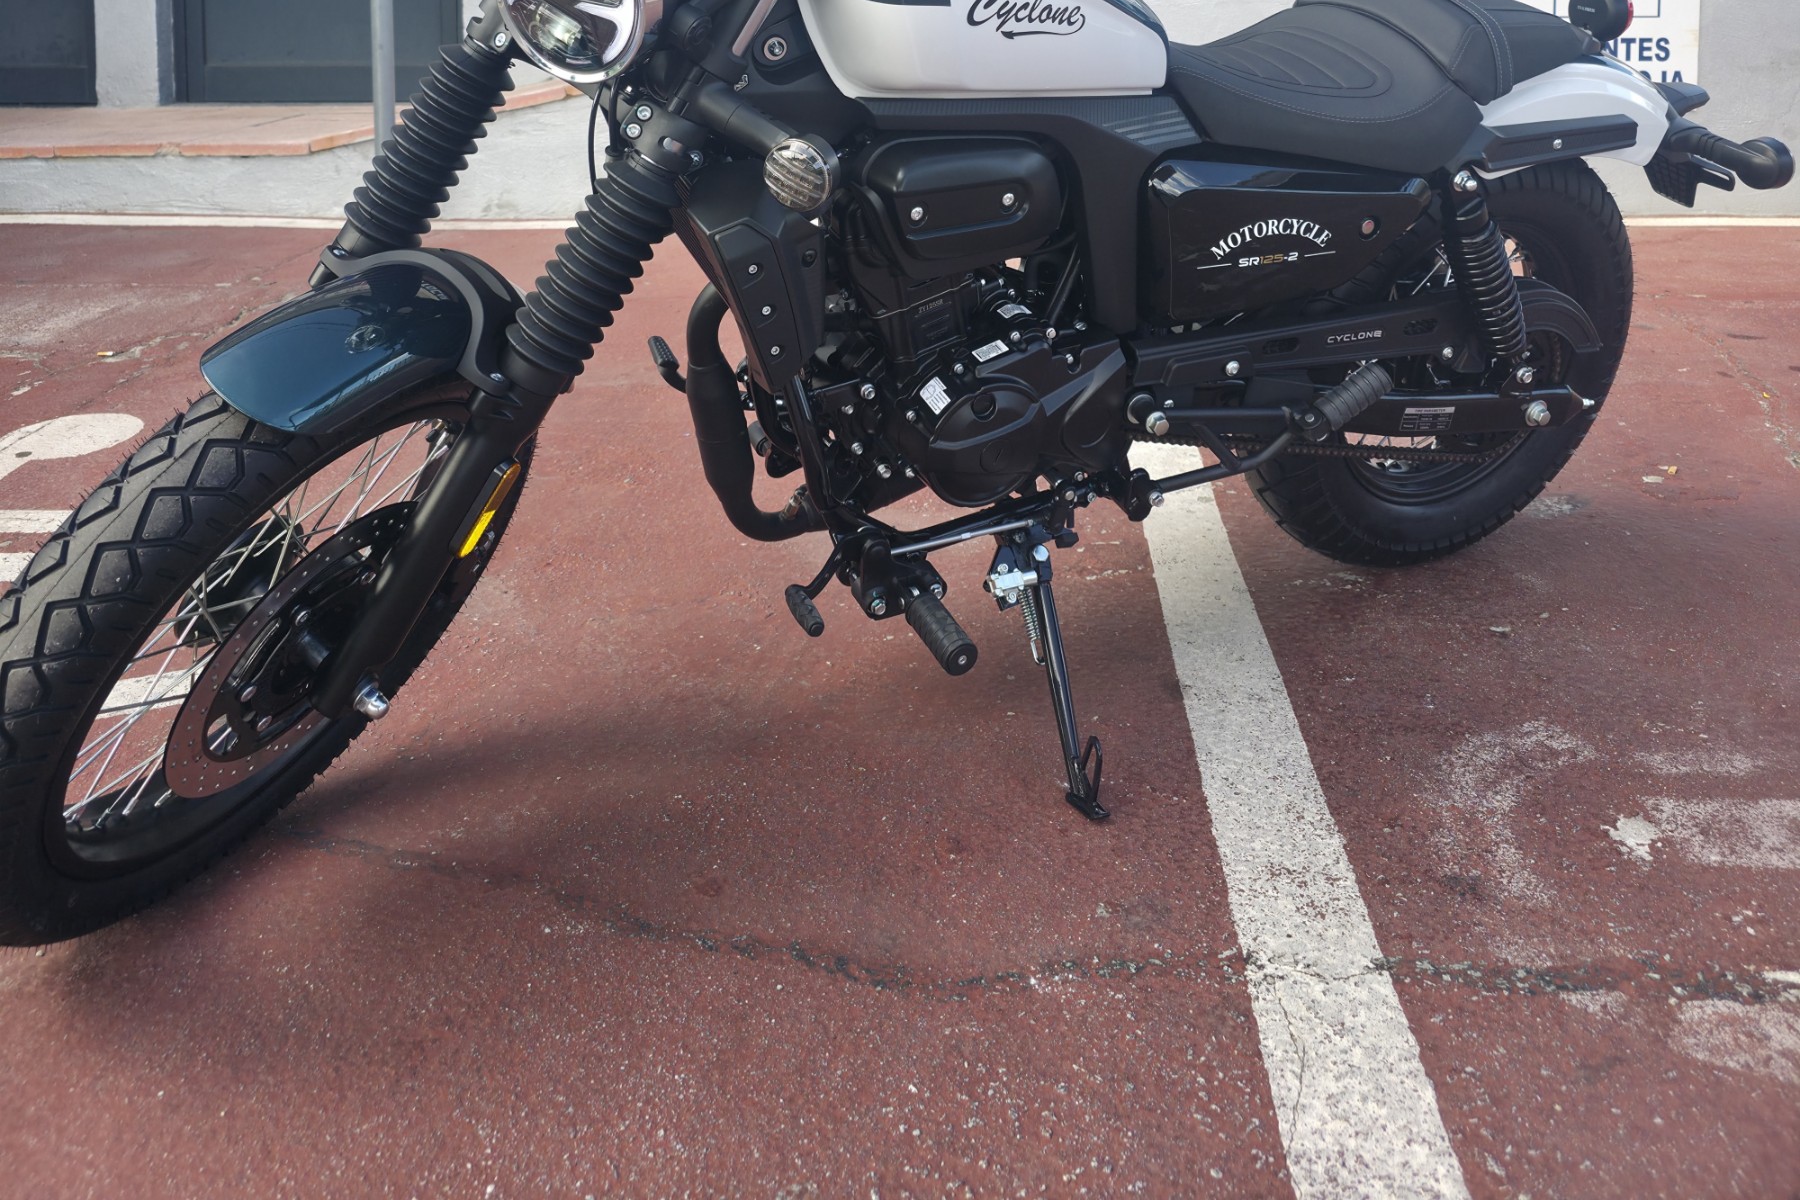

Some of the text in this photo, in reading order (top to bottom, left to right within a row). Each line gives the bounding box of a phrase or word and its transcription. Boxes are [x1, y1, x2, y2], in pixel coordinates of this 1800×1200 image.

[1603, 37, 1671, 62] NTES
[1210, 218, 1332, 260] MOTORCYCLE
[1238, 251, 1299, 267] SR125-2
[1326, 330, 1383, 344] CYCLONE
